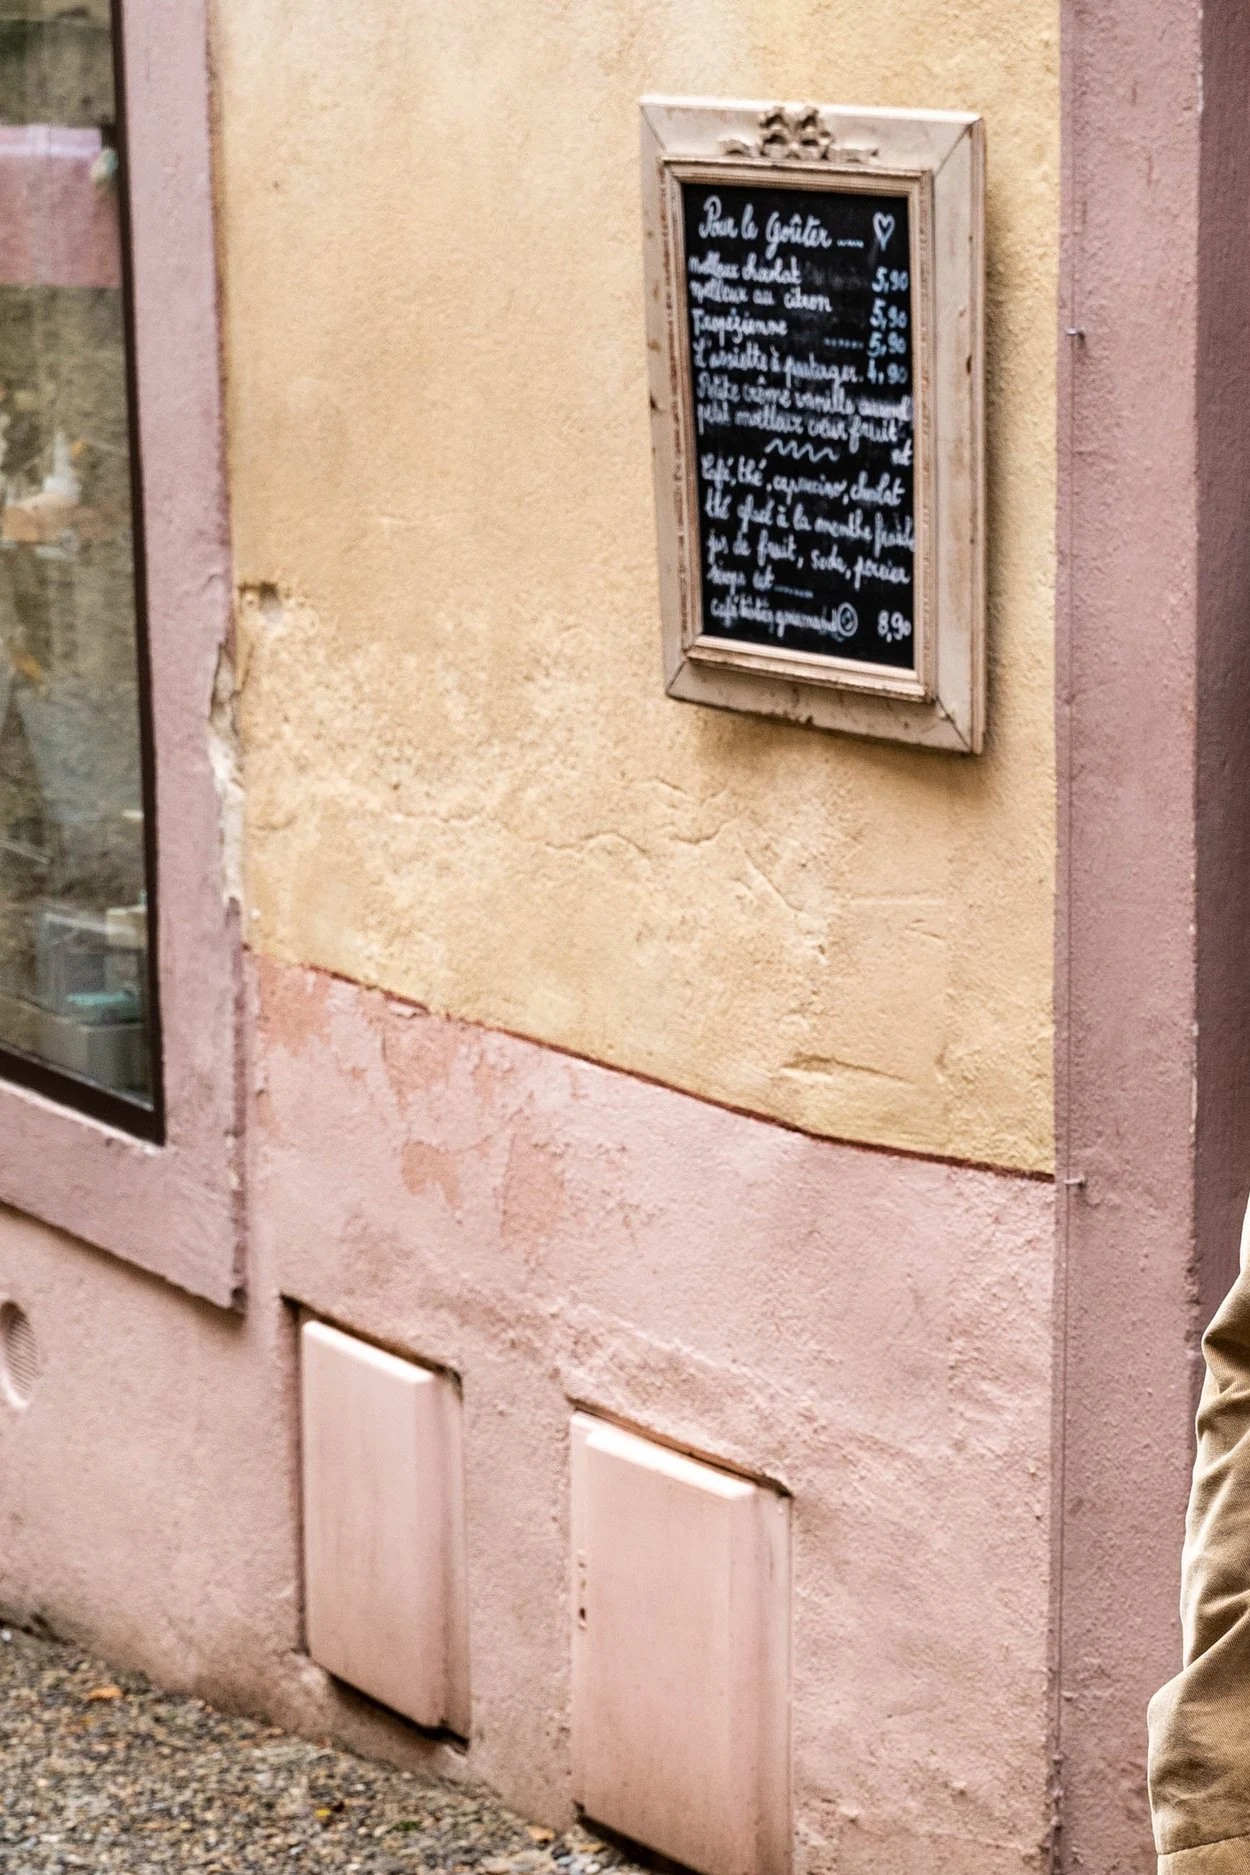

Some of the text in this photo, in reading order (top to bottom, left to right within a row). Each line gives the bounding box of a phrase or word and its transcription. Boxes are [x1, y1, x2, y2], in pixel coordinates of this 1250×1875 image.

[699, 195, 738, 239] Pour
[741, 203, 759, 240] le
[871, 266, 909, 294] 5,90
[869, 298, 908, 331] 5,90
[867, 331, 907, 358] 5,90
[793, 502, 812, 531] la
[878, 609, 912, 643] 8,90
